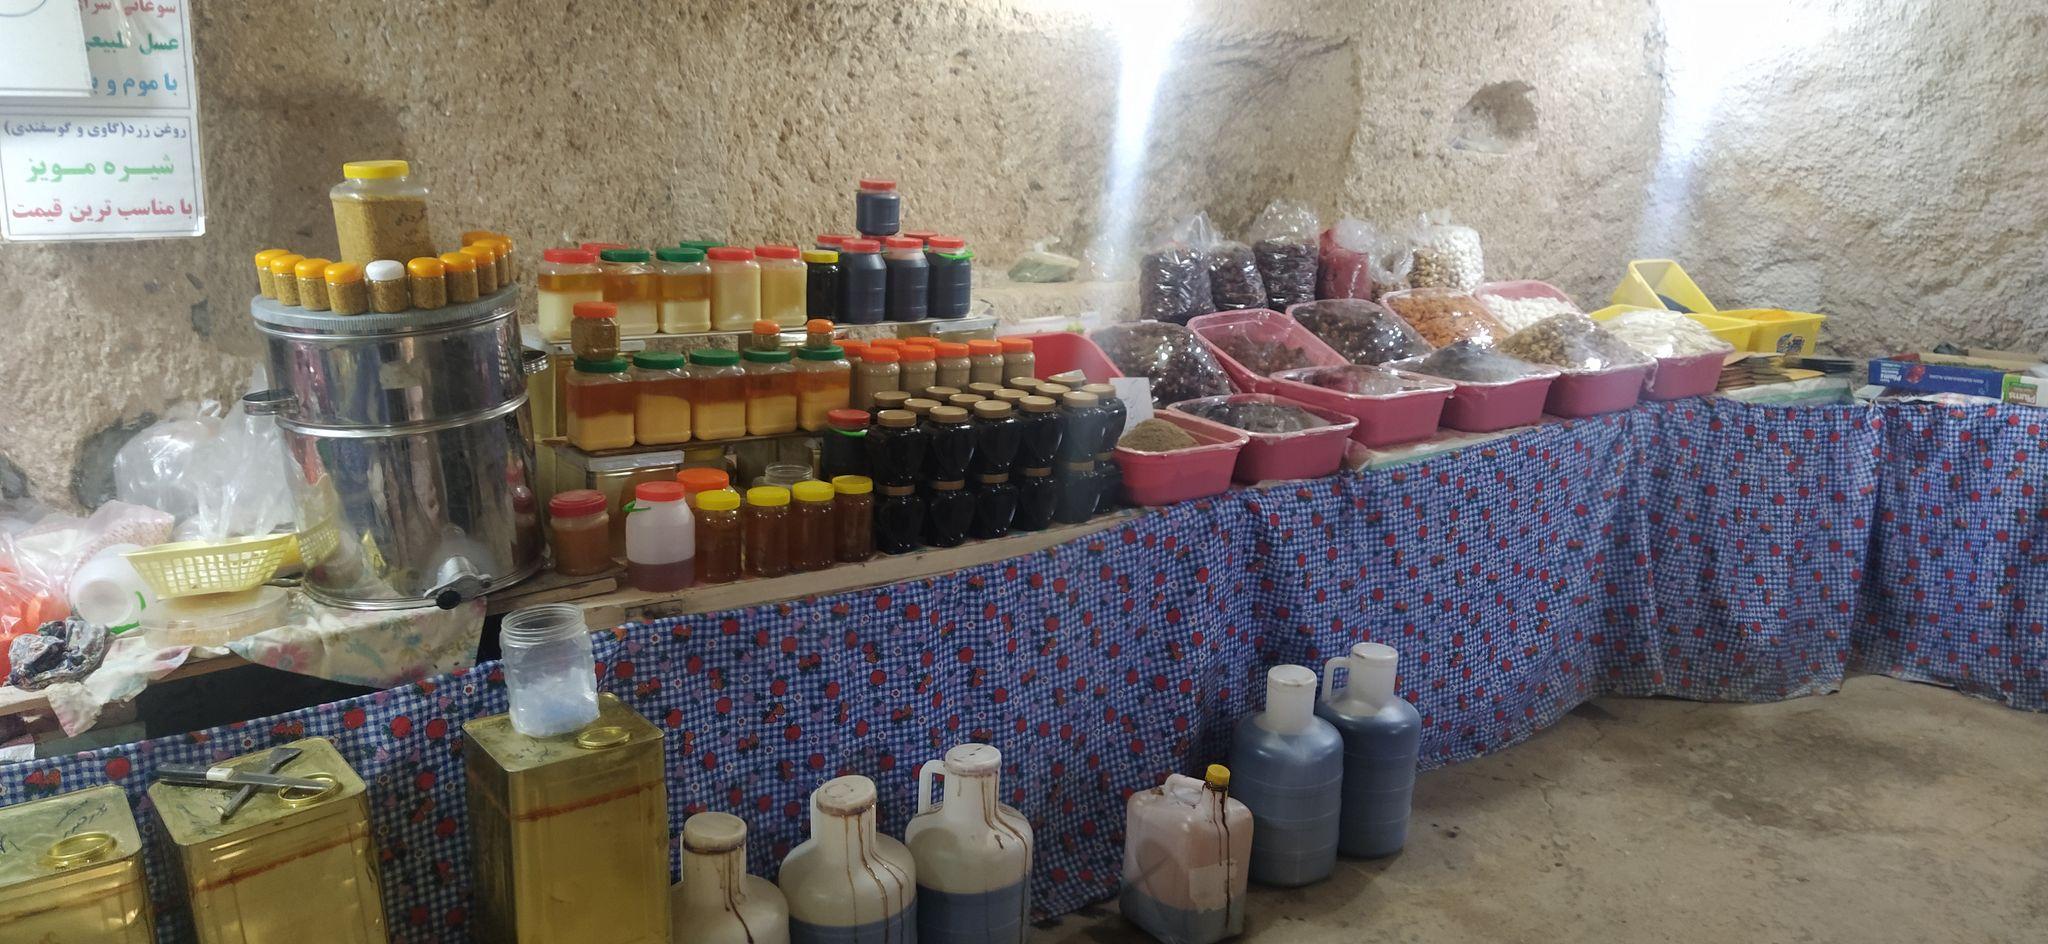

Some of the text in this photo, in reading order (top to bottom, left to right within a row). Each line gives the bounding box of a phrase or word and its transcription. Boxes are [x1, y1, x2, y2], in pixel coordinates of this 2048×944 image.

[139, 33, 179, 55] عسل
[107, 79, 117, 96] و
[123, 77, 158, 96] موم
[163, 73, 178, 96] با
[77, 127, 84, 138] و
[154, 124, 187, 139] روغن
[26, 154, 175, 182] شیره مویز
[12, 198, 193, 222] با مناسب ترین قیمت
